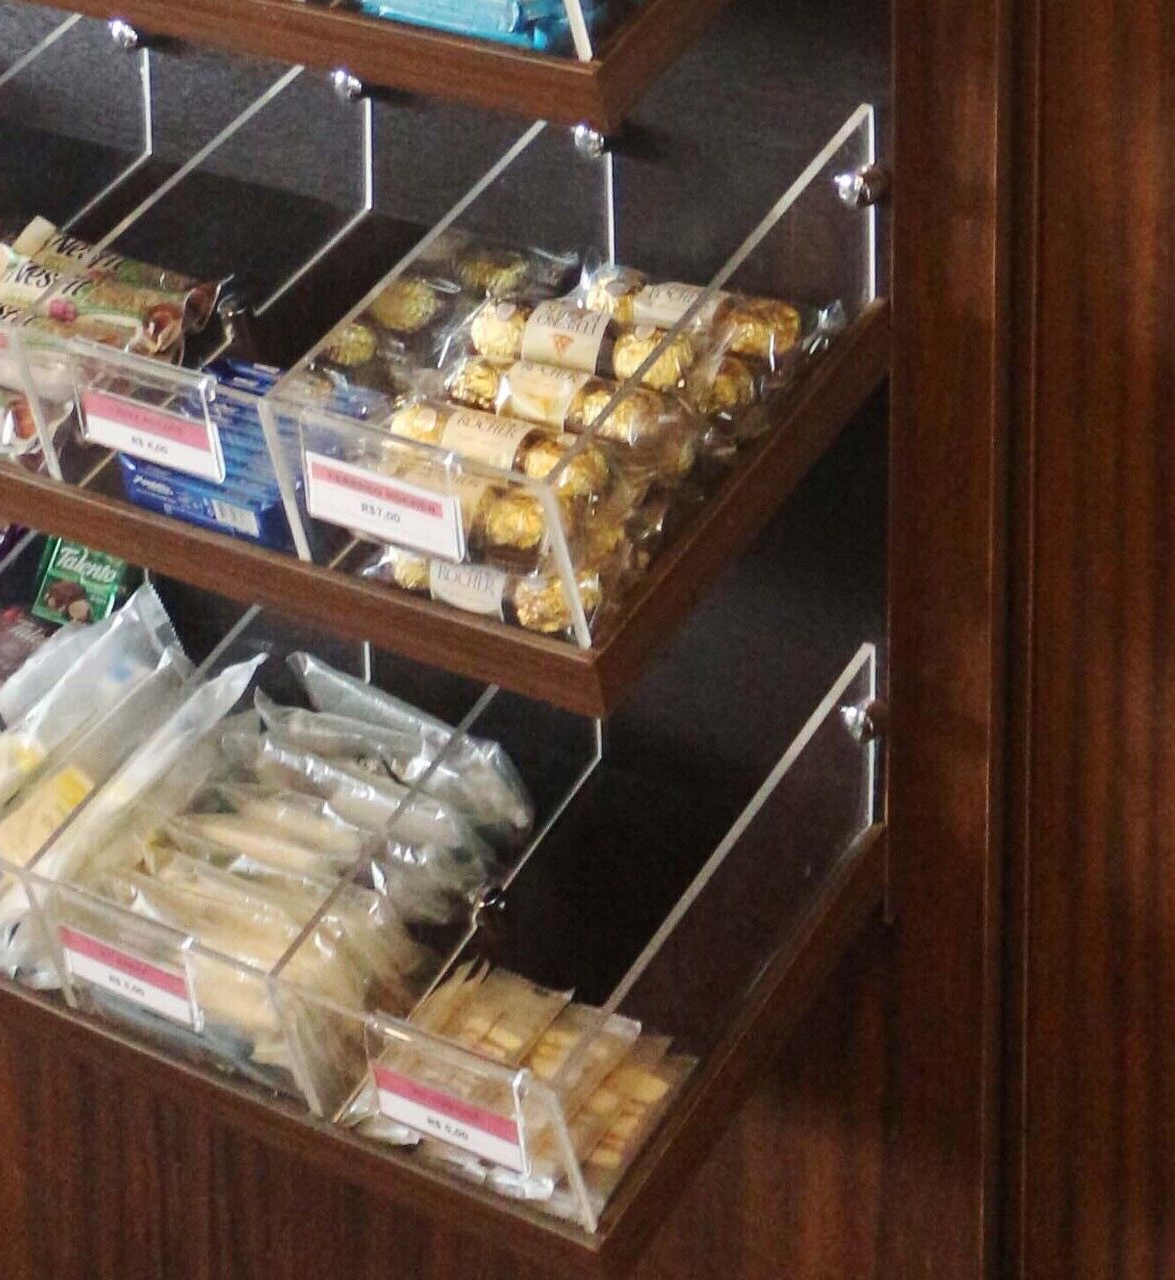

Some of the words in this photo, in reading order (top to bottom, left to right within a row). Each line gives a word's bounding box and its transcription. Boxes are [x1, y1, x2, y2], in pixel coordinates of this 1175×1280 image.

[361, 501, 401, 523] R$7,00
[56, 546, 118, 584] Talento
[446, 1121, 470, 1140] 5,00
